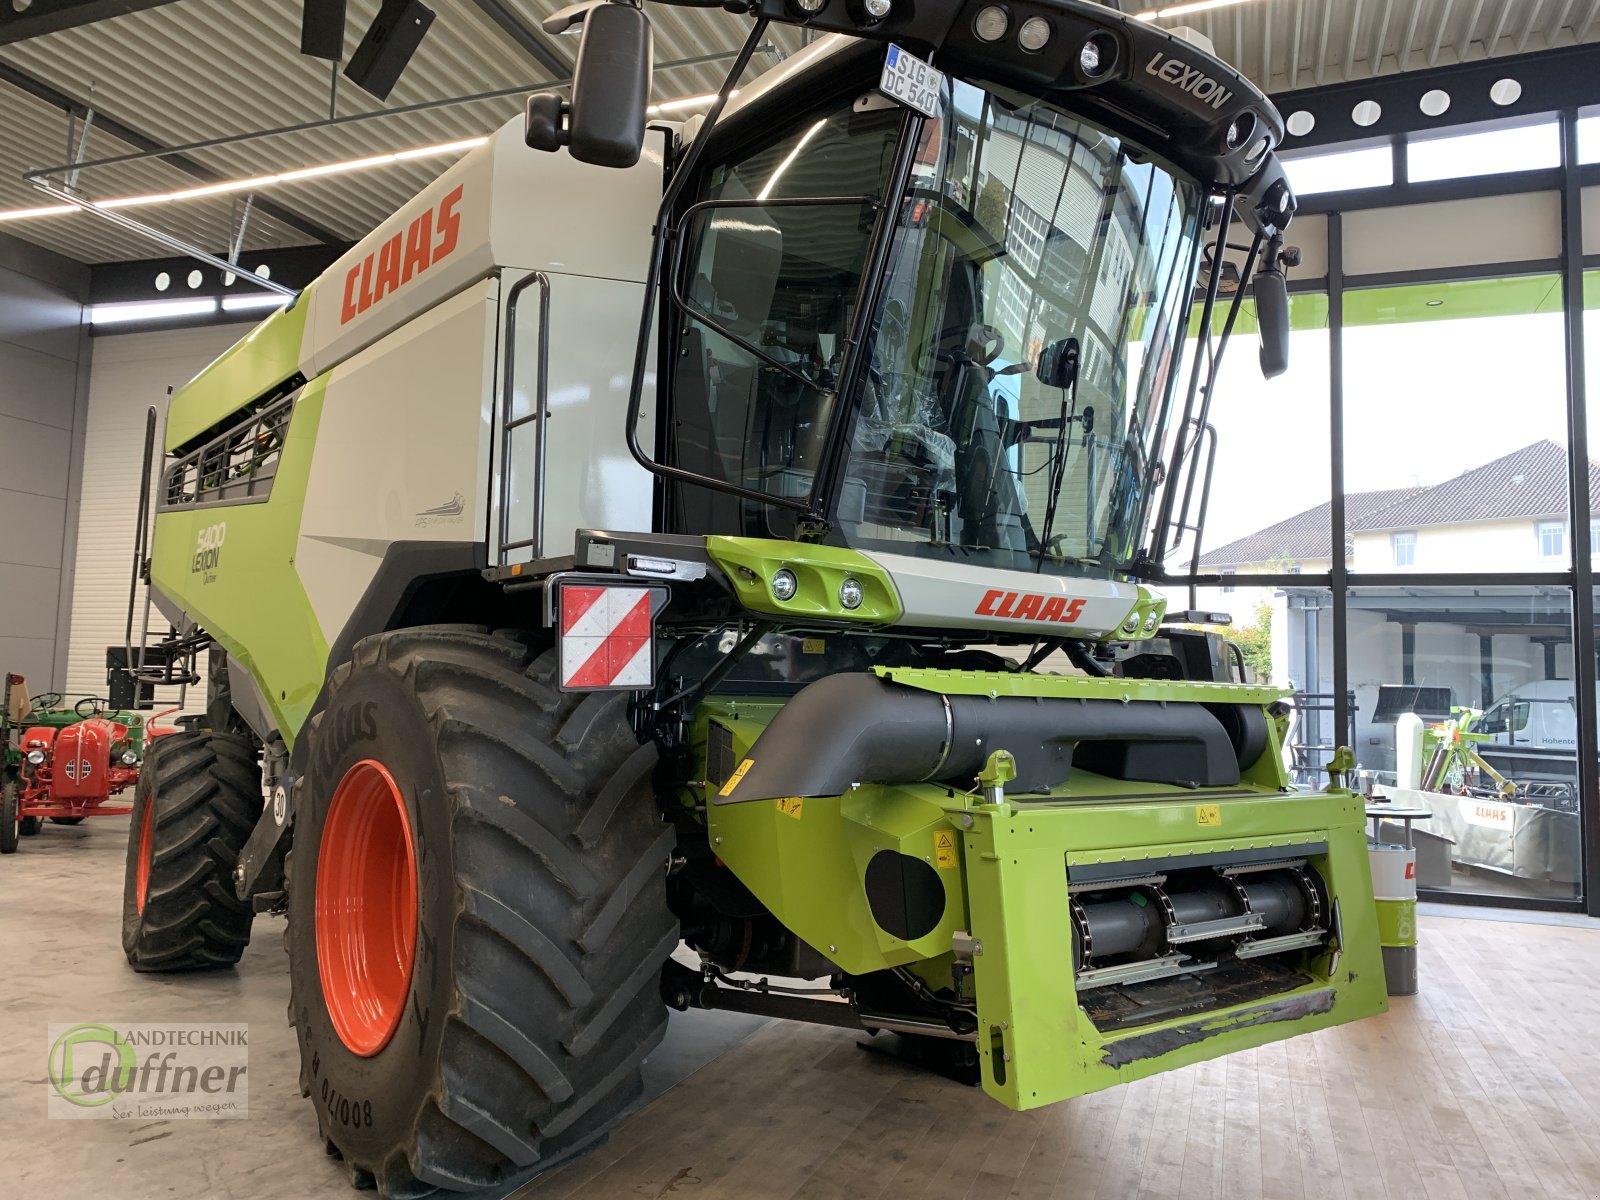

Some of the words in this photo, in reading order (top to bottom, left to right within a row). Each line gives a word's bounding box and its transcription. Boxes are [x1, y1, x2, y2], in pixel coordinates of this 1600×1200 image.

[897, 54, 927, 86] SIG
[1145, 51, 1233, 110] LEXION
[884, 70, 905, 97] DC
[907, 82, 936, 112] 540
[340, 182, 464, 326] CLAAS
[195, 521, 227, 557] 5400
[191, 546, 220, 574] LEXION
[974, 589, 1088, 623] CLAAS
[275, 792, 285, 819] 30
[1475, 806, 1507, 822] CLAAS
